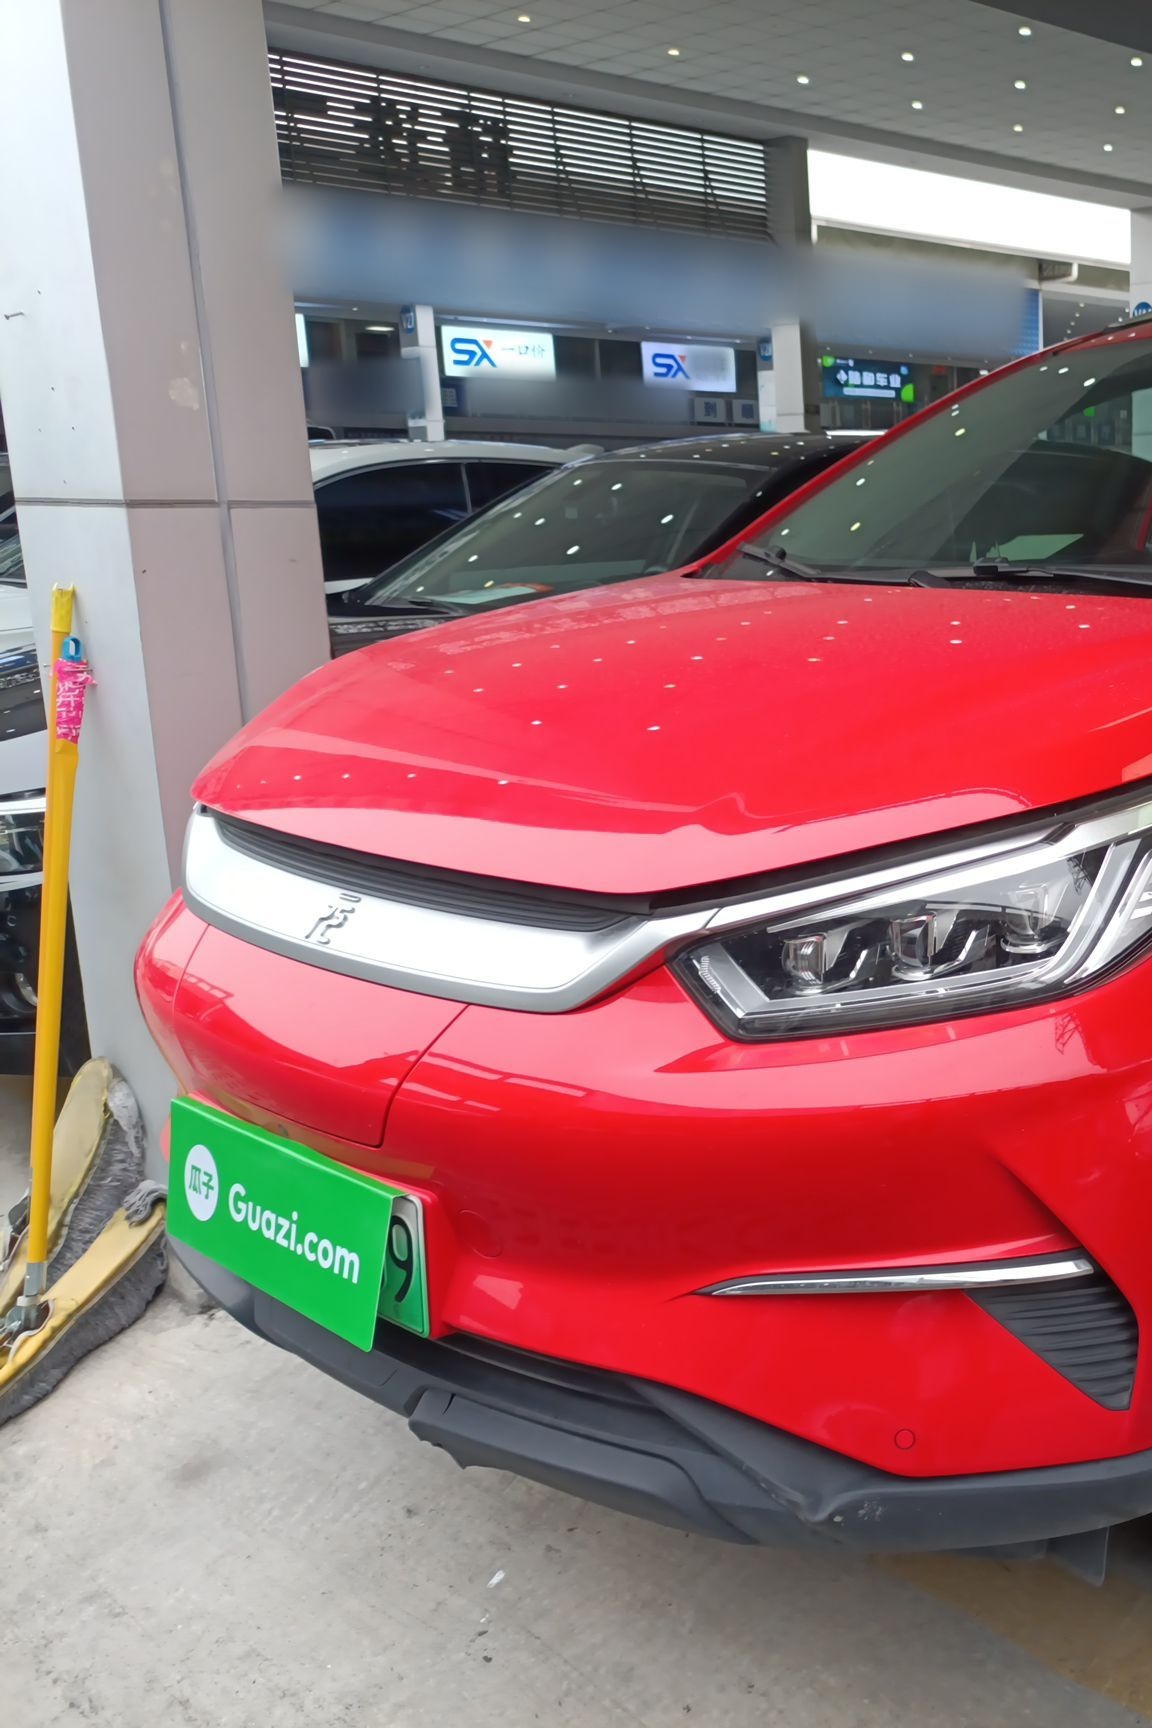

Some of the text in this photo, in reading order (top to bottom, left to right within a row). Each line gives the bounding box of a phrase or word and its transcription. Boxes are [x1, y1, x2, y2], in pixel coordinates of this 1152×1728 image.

[188, 1164, 215, 1200] 瓜子
[228, 1183, 360, 1284] Guazi.com
[387, 1214, 414, 1304] 9
